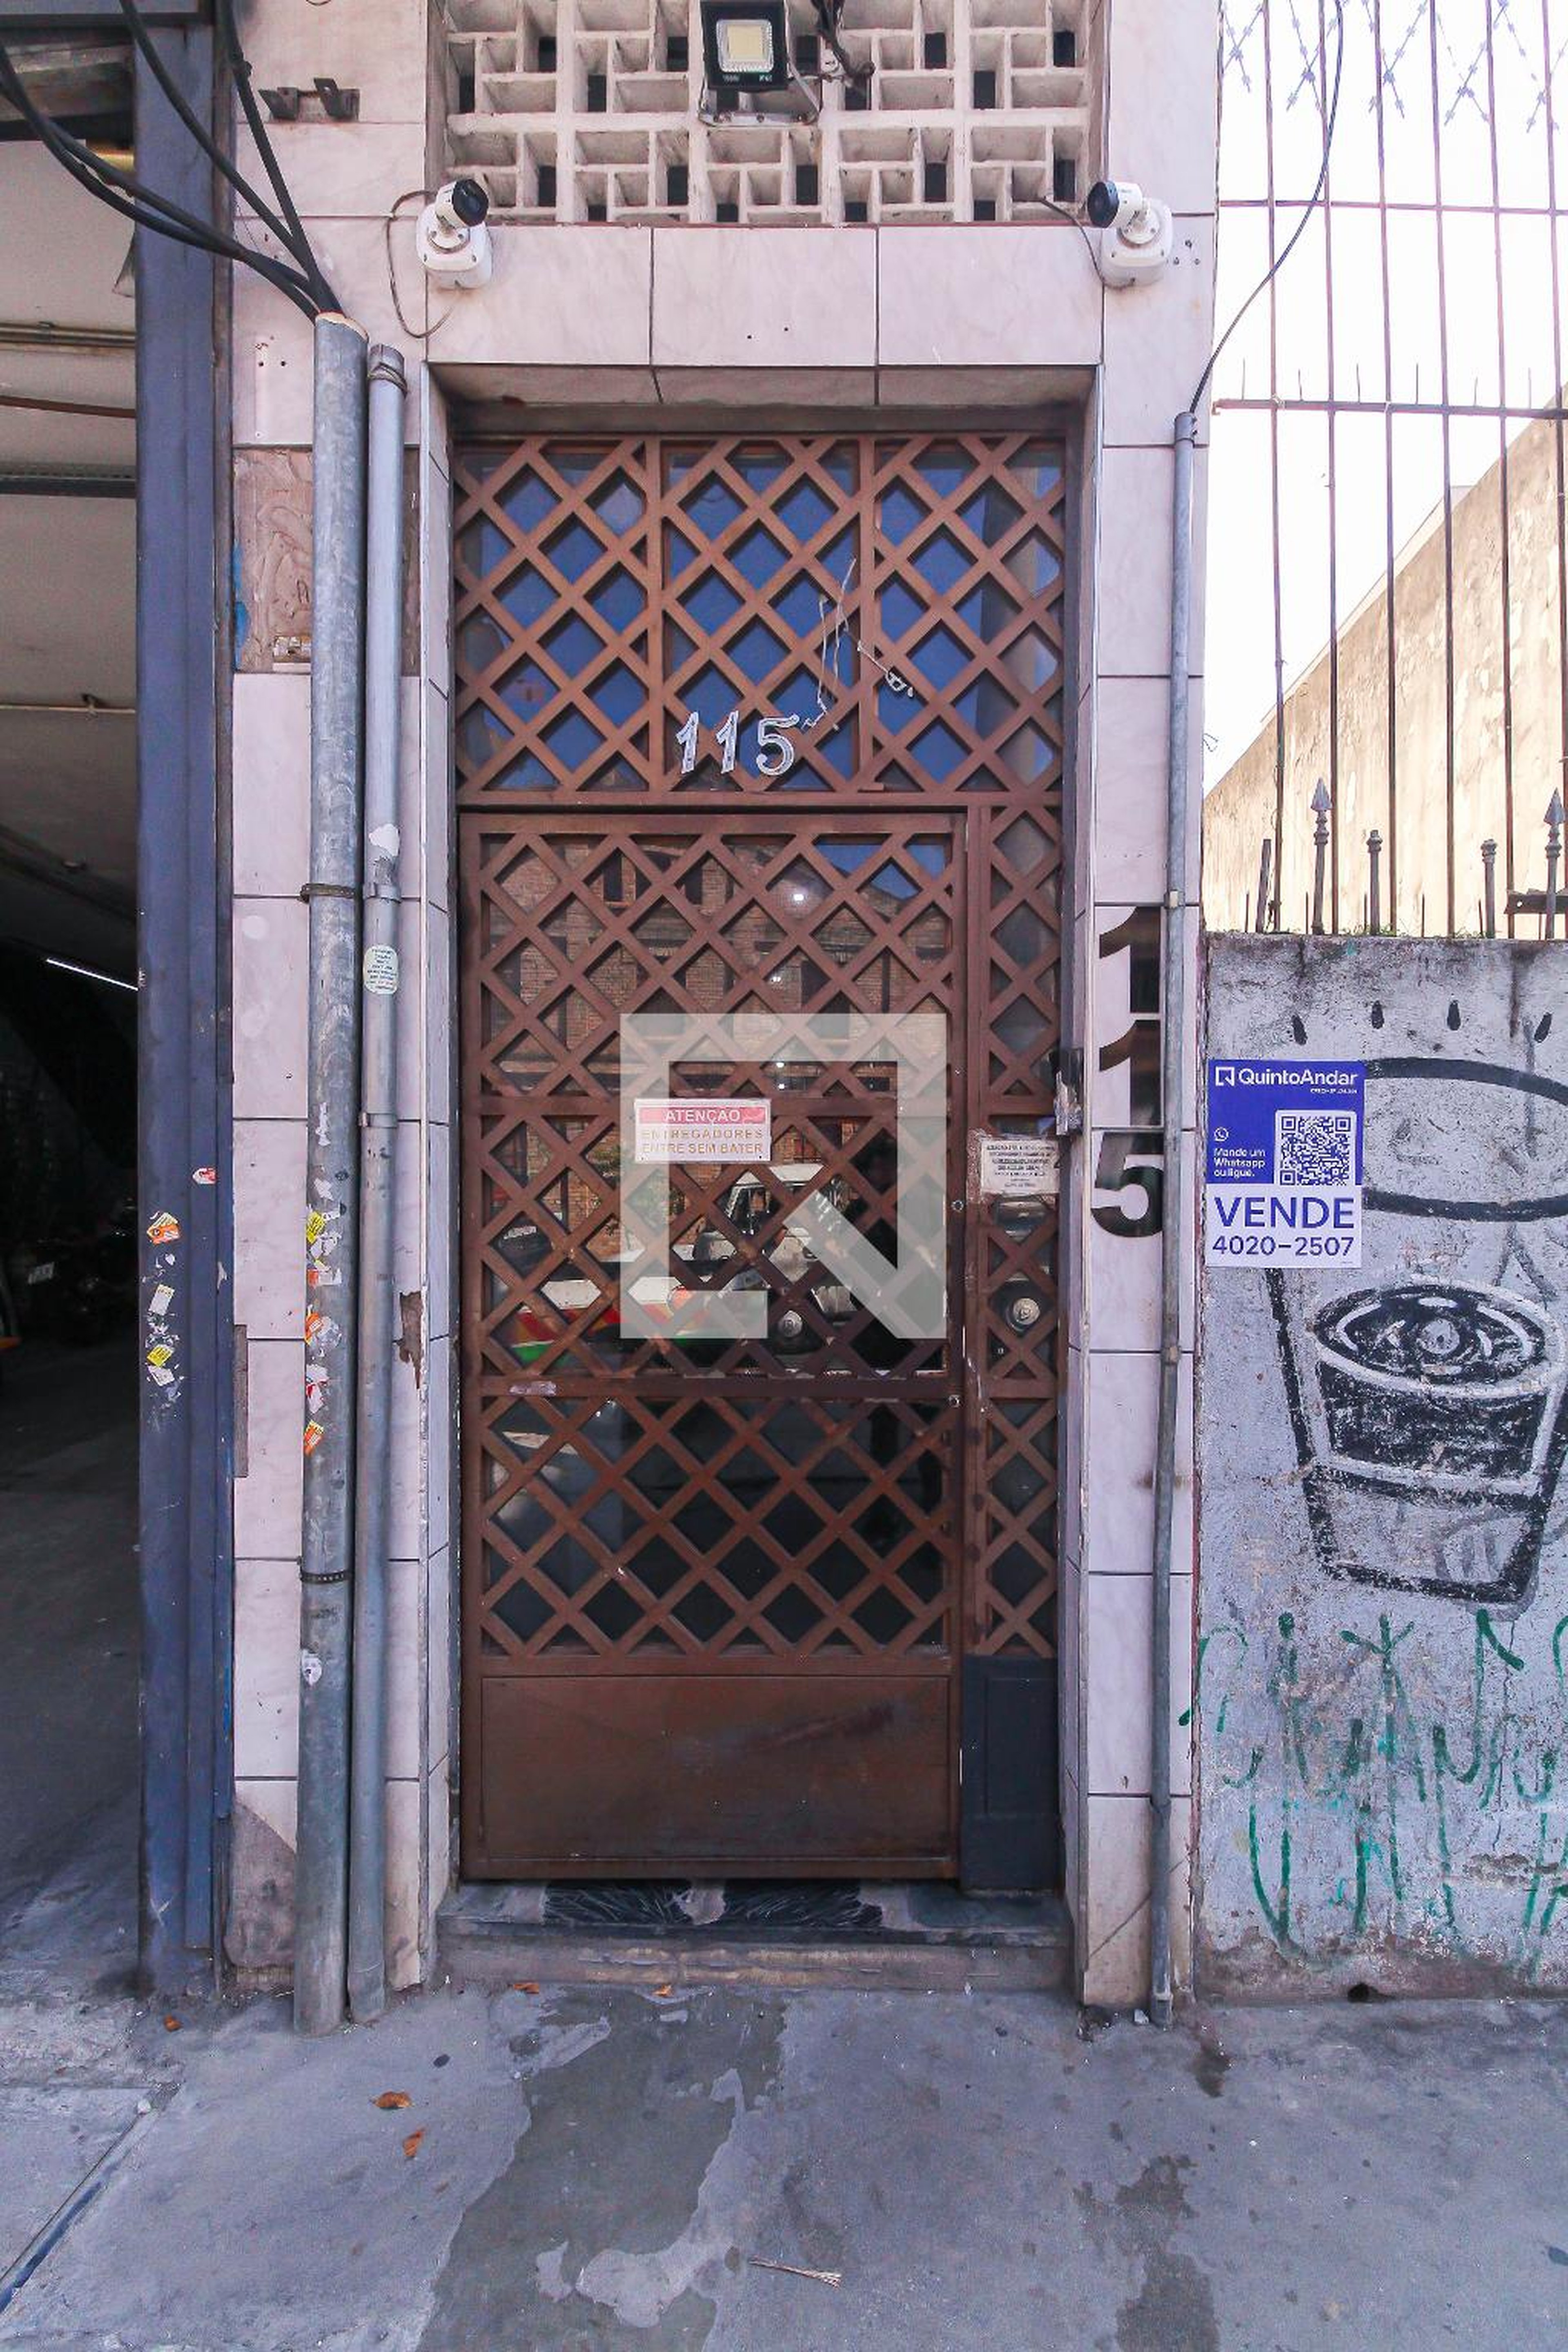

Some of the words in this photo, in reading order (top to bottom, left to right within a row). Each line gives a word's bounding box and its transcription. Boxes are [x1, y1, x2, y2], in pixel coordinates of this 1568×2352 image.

[675, 710, 800, 775] 115
[1091, 906, 1164, 1238] 115
[1238, 1068, 1359, 1085] QuintoAndar
[641, 1129, 762, 1139] ENTREGADORES
[642, 1143, 685, 1154] ENTRE
[688, 1143, 715, 1154] SEM
[721, 1143, 763, 1154] BATER
[1214, 1147, 1247, 1157] Mande
[1250, 1149, 1266, 1157] um
[1213, 1157, 1265, 1169] Whatsapp
[1214, 1197, 1354, 1229] VENDE
[1212, 1235, 1354, 1256] 4020-2507
